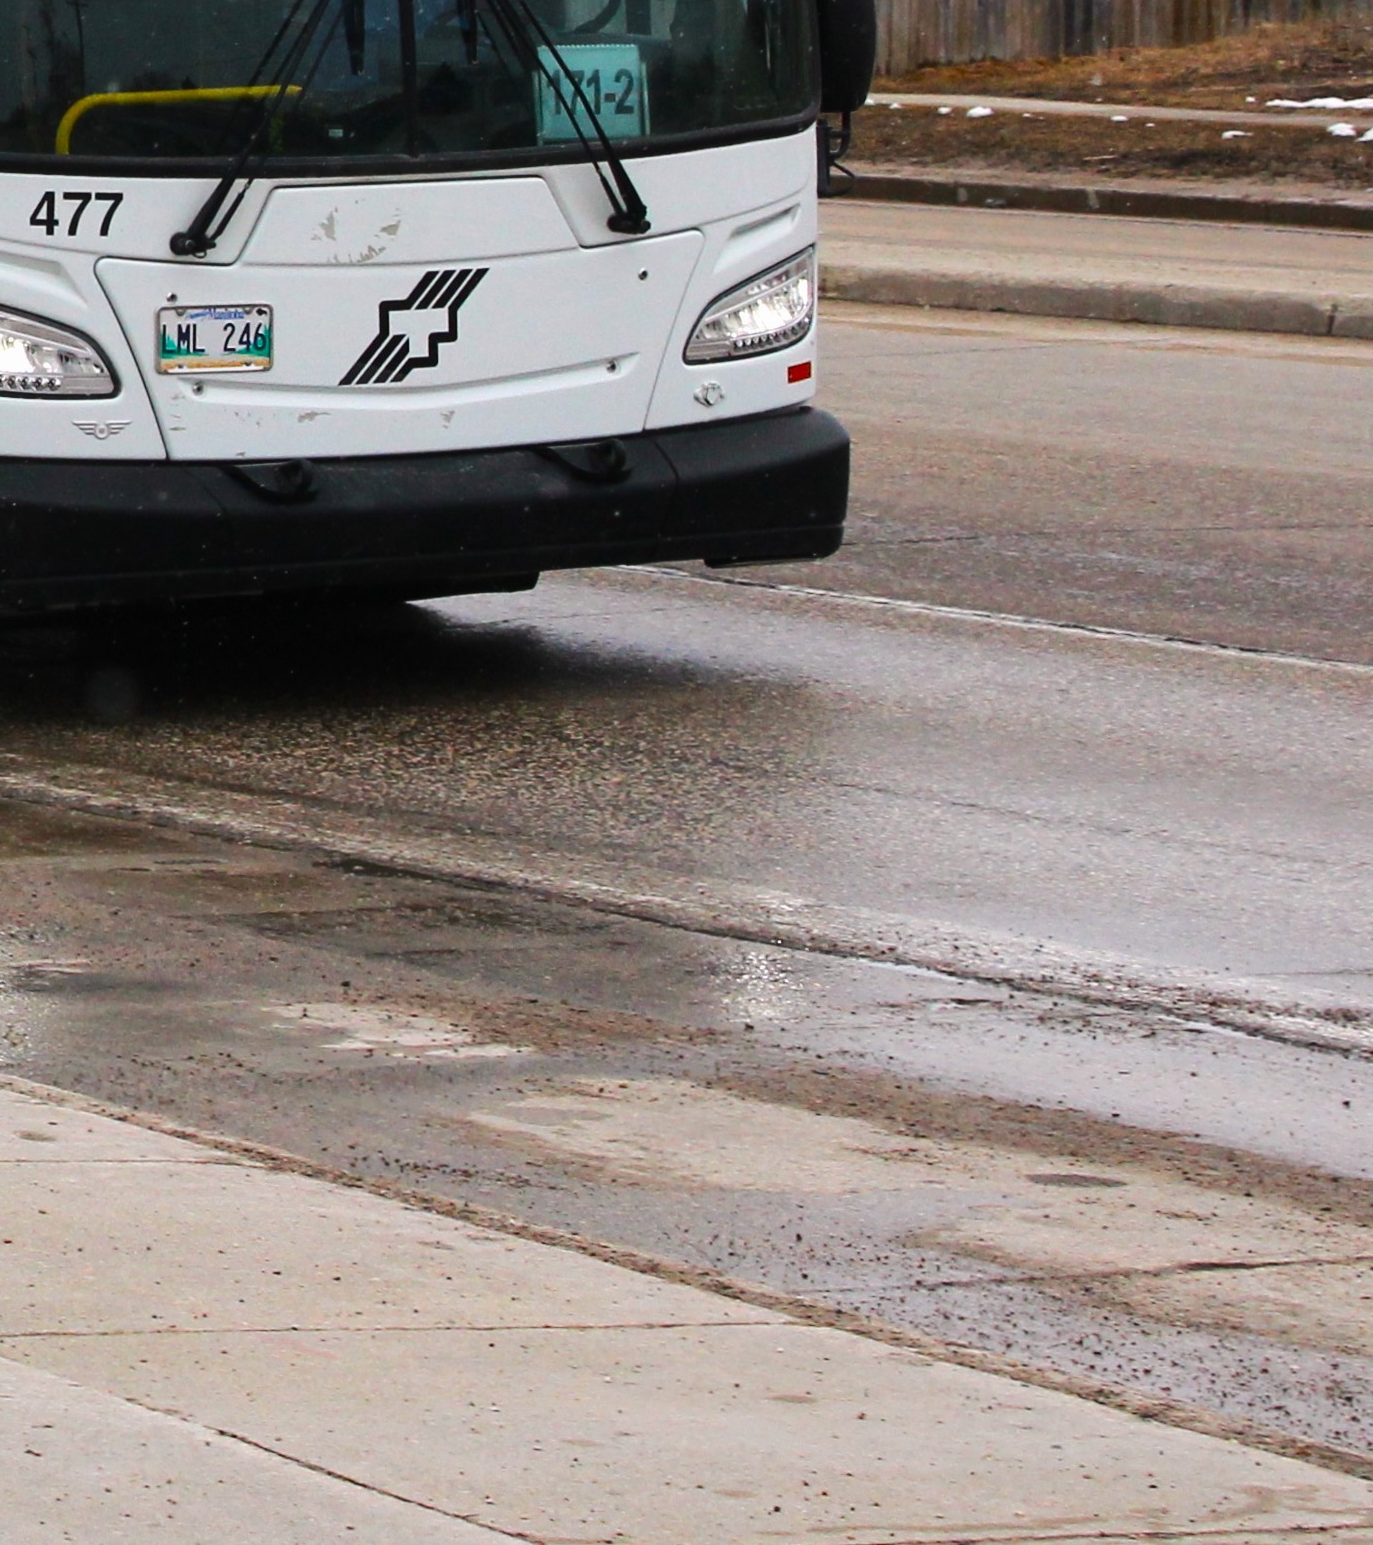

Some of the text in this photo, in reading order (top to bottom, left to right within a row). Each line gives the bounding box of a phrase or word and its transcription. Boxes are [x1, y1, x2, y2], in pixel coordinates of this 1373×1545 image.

[547, 68, 635, 116] 171-2
[29, 191, 124, 238] 477
[162, 322, 267, 353] LML 246
